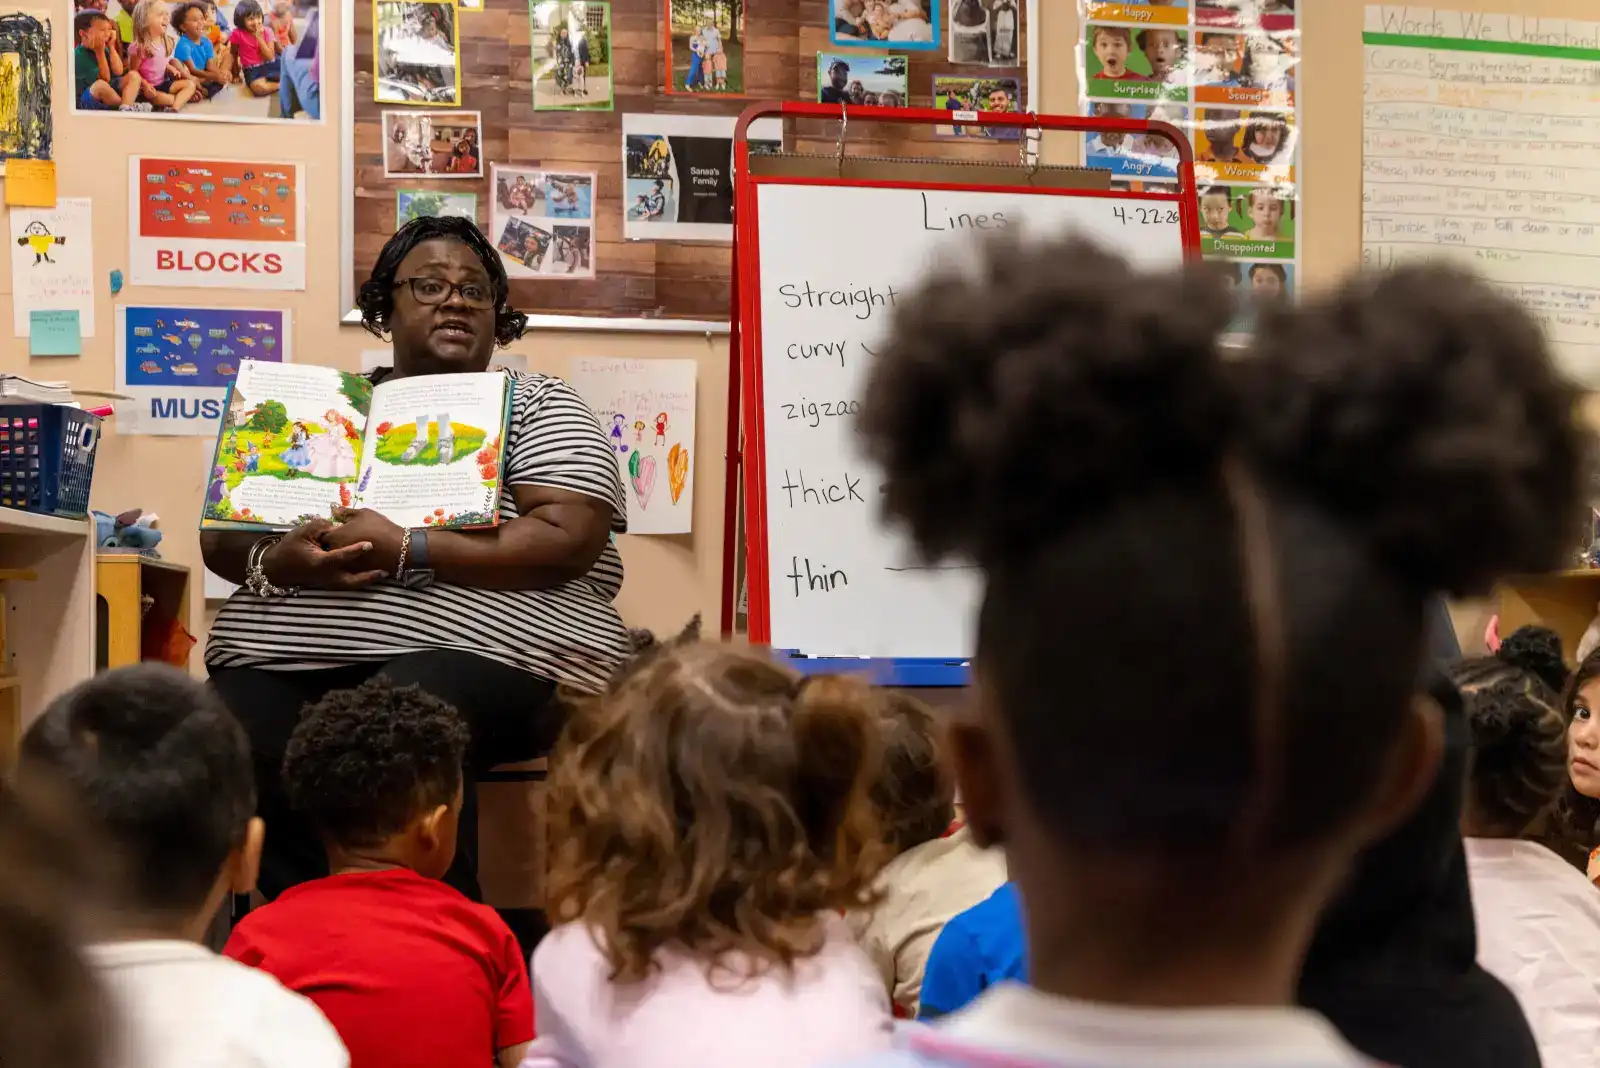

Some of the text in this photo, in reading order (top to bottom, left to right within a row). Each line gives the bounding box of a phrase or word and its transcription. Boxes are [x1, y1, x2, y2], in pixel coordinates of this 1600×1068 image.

[1122, 8, 1153, 20] Happy
[1380, 5, 1600, 49] Words We Understand
[1113, 82, 1262, 101] Surprised Scared
[1121, 160, 1266, 177] Angry Worrie
[692, 176, 718, 188] Family
[921, 192, 1008, 231] Lines
[1113, 206, 1179, 225] 4-22-26
[1214, 239, 1276, 254] Disappointed
[156, 250, 283, 275] BLOCKS
[779, 281, 898, 319] Straight
[787, 340, 846, 368] curvy
[151, 398, 226, 419] MUS
[781, 470, 865, 508] thick
[786, 556, 848, 598] thin
